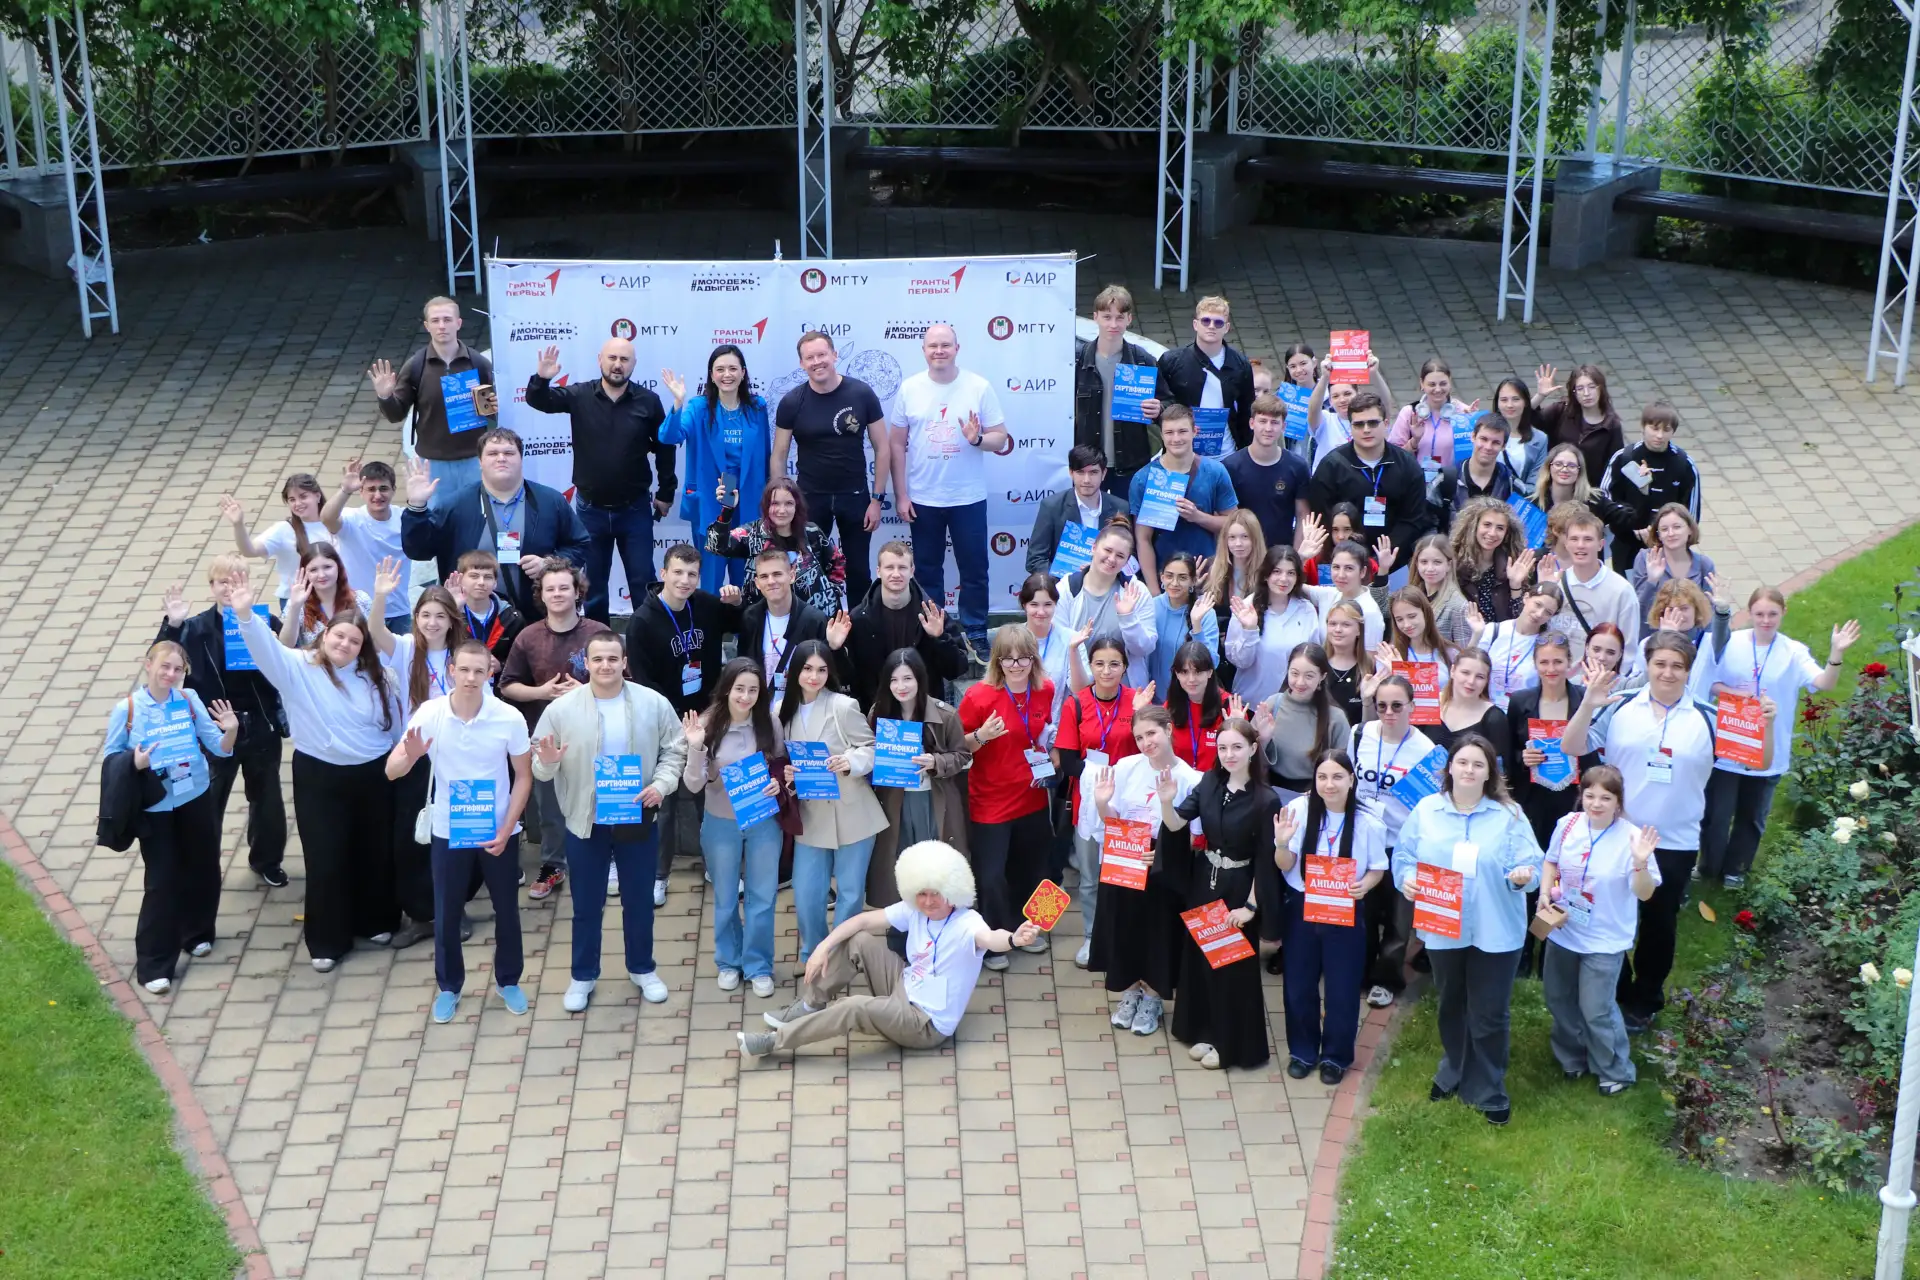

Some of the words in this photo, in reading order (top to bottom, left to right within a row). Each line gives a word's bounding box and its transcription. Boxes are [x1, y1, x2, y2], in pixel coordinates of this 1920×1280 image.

[619, 276, 651, 288] АИР
[831, 275, 868, 286] МГТУ
[1023, 272, 1056, 285] АИР
[508, 281, 546, 289] ГРАНТЫ
[641, 325, 678, 336] МГТУ
[820, 323, 851, 336] АИР
[1018, 323, 1055, 334] МГТУ
[1334, 348, 1365, 357] ДИПЛОМ
[1024, 379, 1056, 391] АИР
[1114, 384, 1153, 394] СЕРТИФИКАТ
[1018, 439, 1055, 448] МГТУ
[1721, 715, 1760, 732] ДИПЛОМ
[147, 722, 191, 738] СЕРТИФИКАТ
[876, 742, 919, 754] СЕРТИФИКАТ
[597, 779, 640, 788] СЕРТИФИКАТ
[728, 775, 768, 798] СЕРТИФИКАТ
[450, 804, 493, 813] СЕРТИФИКАТ
[1108, 838, 1145, 854] ДИПЛОМ
[1310, 877, 1350, 891] ДИПЛОМ
[1420, 885, 1457, 903] ДИПЛОМ
